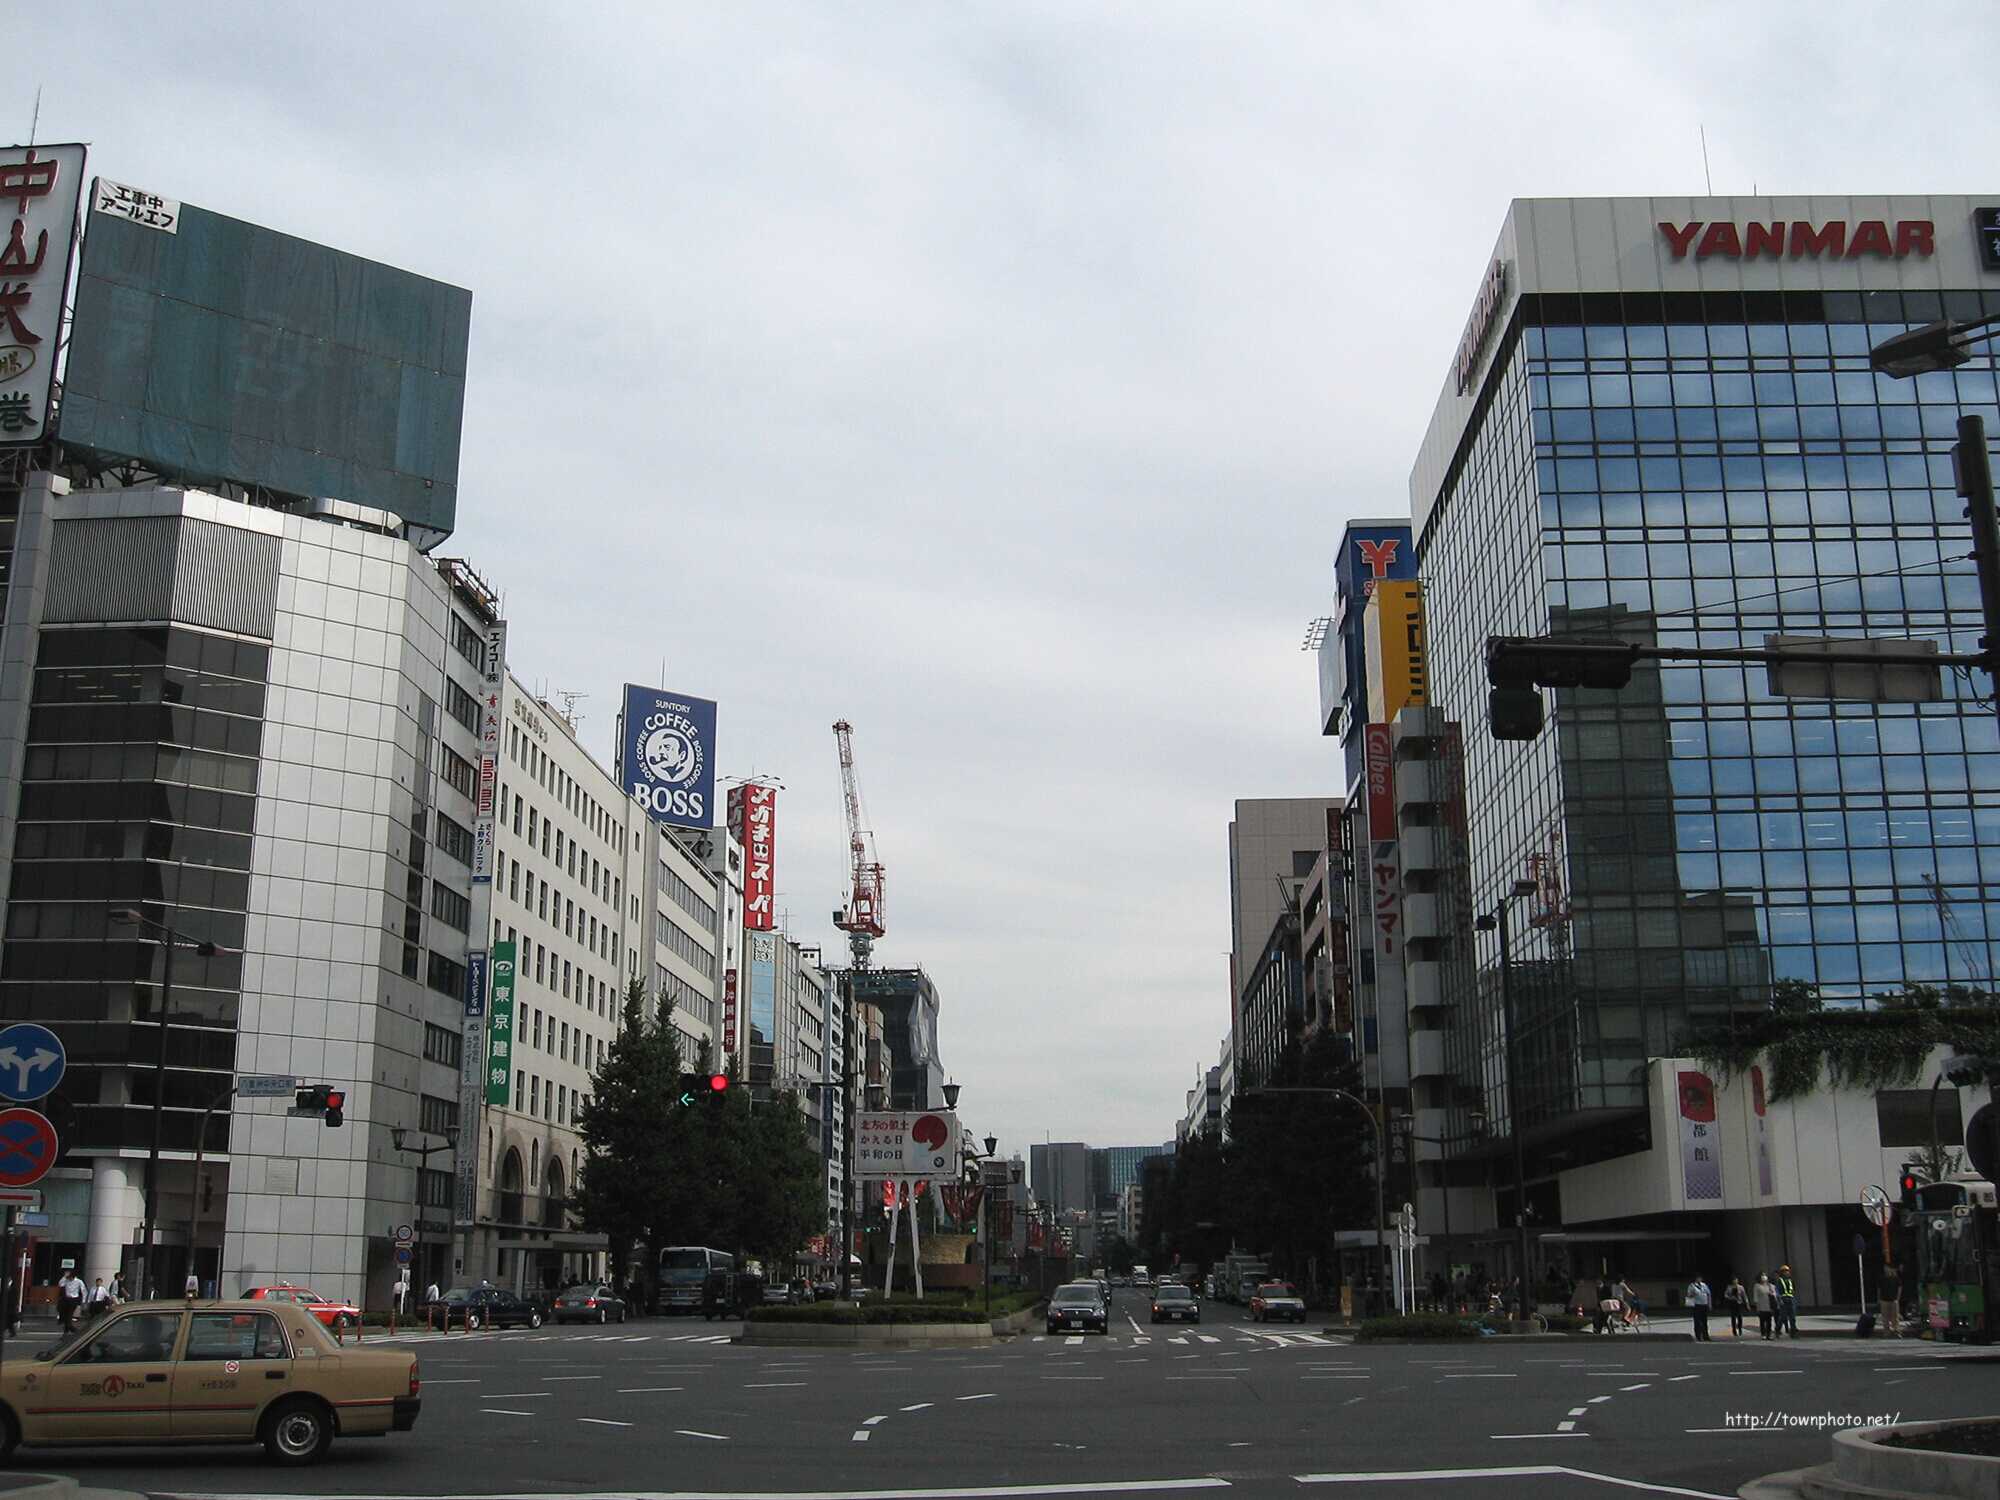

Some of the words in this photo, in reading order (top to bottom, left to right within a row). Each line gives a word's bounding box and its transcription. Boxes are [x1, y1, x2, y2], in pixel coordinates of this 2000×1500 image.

[101, 197, 174, 228] アールエフ
[1658, 221, 1935, 257] YANMAR
[655, 699, 692, 714] SUNTORY
[644, 712, 699, 740] COFFEE
[636, 729, 649, 761] COFFEE
[638, 760, 656, 784] BOSS
[1368, 730, 1390, 796] Calbee
[632, 782, 704, 819] BOSS
[1374, 863, 1398, 954] ヤンマー
[491, 985, 511, 1085] 東京建物
[861, 1119, 910, 1131] 北方の領土
[861, 1135, 903, 1145] かえる日
[861, 1150, 903, 1160] 平和の日
